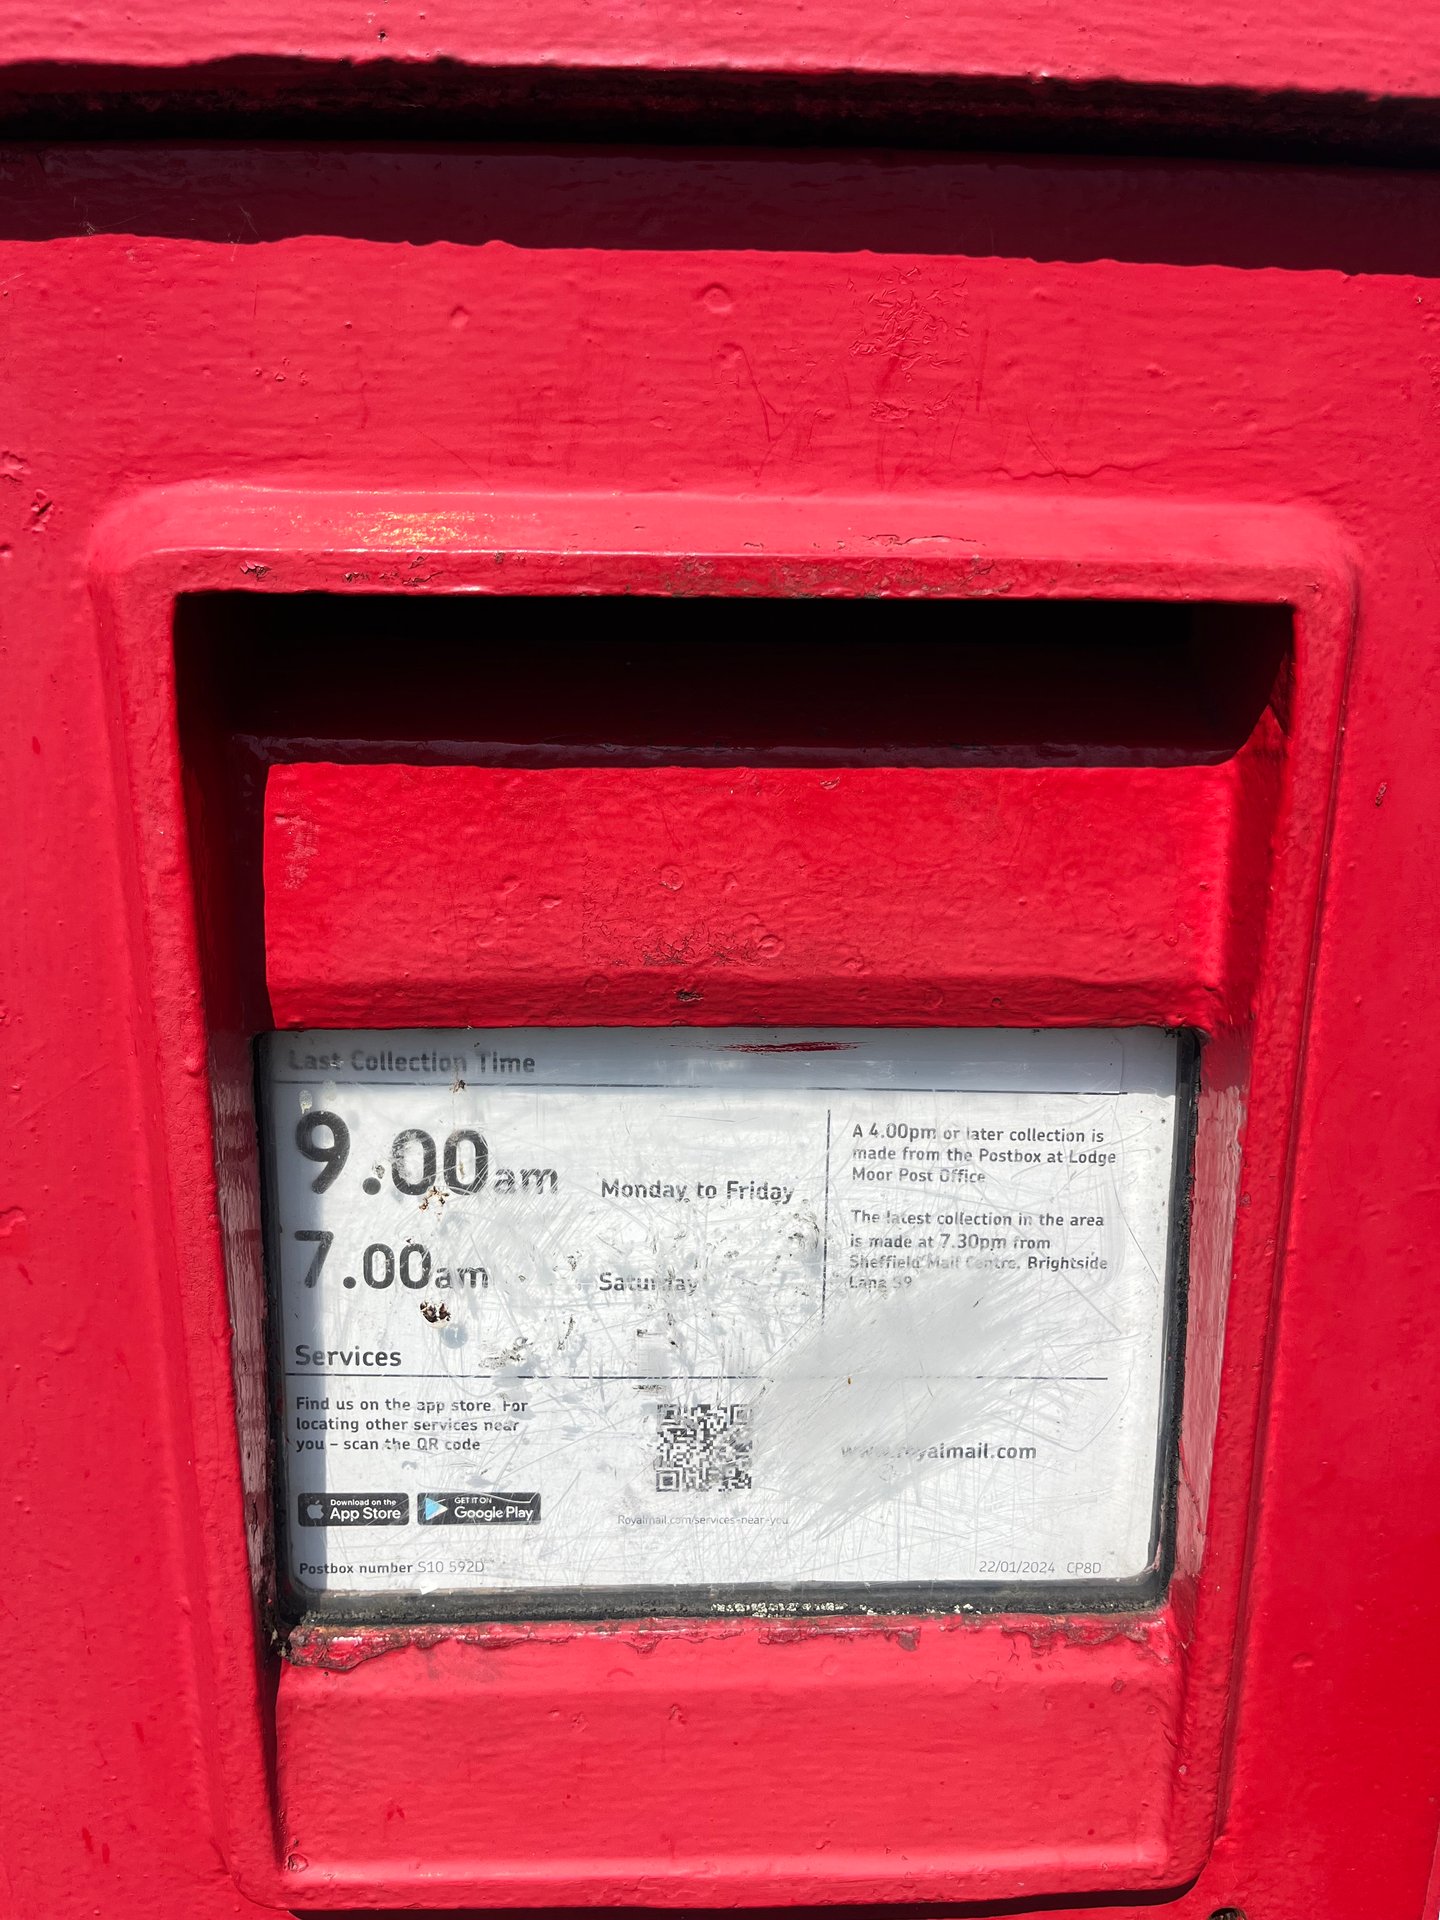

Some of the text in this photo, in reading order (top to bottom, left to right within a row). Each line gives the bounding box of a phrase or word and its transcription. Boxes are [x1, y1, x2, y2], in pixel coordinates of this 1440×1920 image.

[288, 1049, 536, 1073] Last Collection Time
[852, 1123, 1104, 1143] A 4.00pm or later collection is
[295, 1110, 558, 1196] 9.00am
[852, 1146, 1116, 1167] made from the Postbox at Lodge
[852, 1167, 986, 1183] Moor Post Office
[601, 1179, 795, 1204] Monday to Friday
[851, 1209, 1104, 1227] The latest collection in the area
[850, 1233, 1050, 1251] is made at 7.30pm from
[294, 1230, 489, 1289] 7.00am
[1028, 1255, 1108, 1272] Brightside
[295, 1344, 402, 1367] Services
[296, 1397, 330, 1411] Find
[336, 1400, 354, 1411] us
[360, 1400, 379, 1411] on
[385, 1398, 411, 1411] the
[417, 1401, 445, 1414] app
[503, 1400, 528, 1412] For
[296, 1417, 519, 1432] locating other services near
[296, 1439, 325, 1452] you
[343, 1440, 379, 1451] scan
[384, 1438, 411, 1451] the
[417, 1438, 439, 1451] QR
[445, 1438, 481, 1451] code
[841, 1442, 1037, 1462] w.yalmail.com
[383, 1499, 397, 1507] the
[454, 1496, 470, 1504] GET
[330, 1507, 401, 1522] App Store
[454, 1505, 534, 1521] Google Play
[299, 1560, 485, 1575] Postbox number S10 592D
[978, 1560, 1102, 1574] 22/01/2024 CP8D
